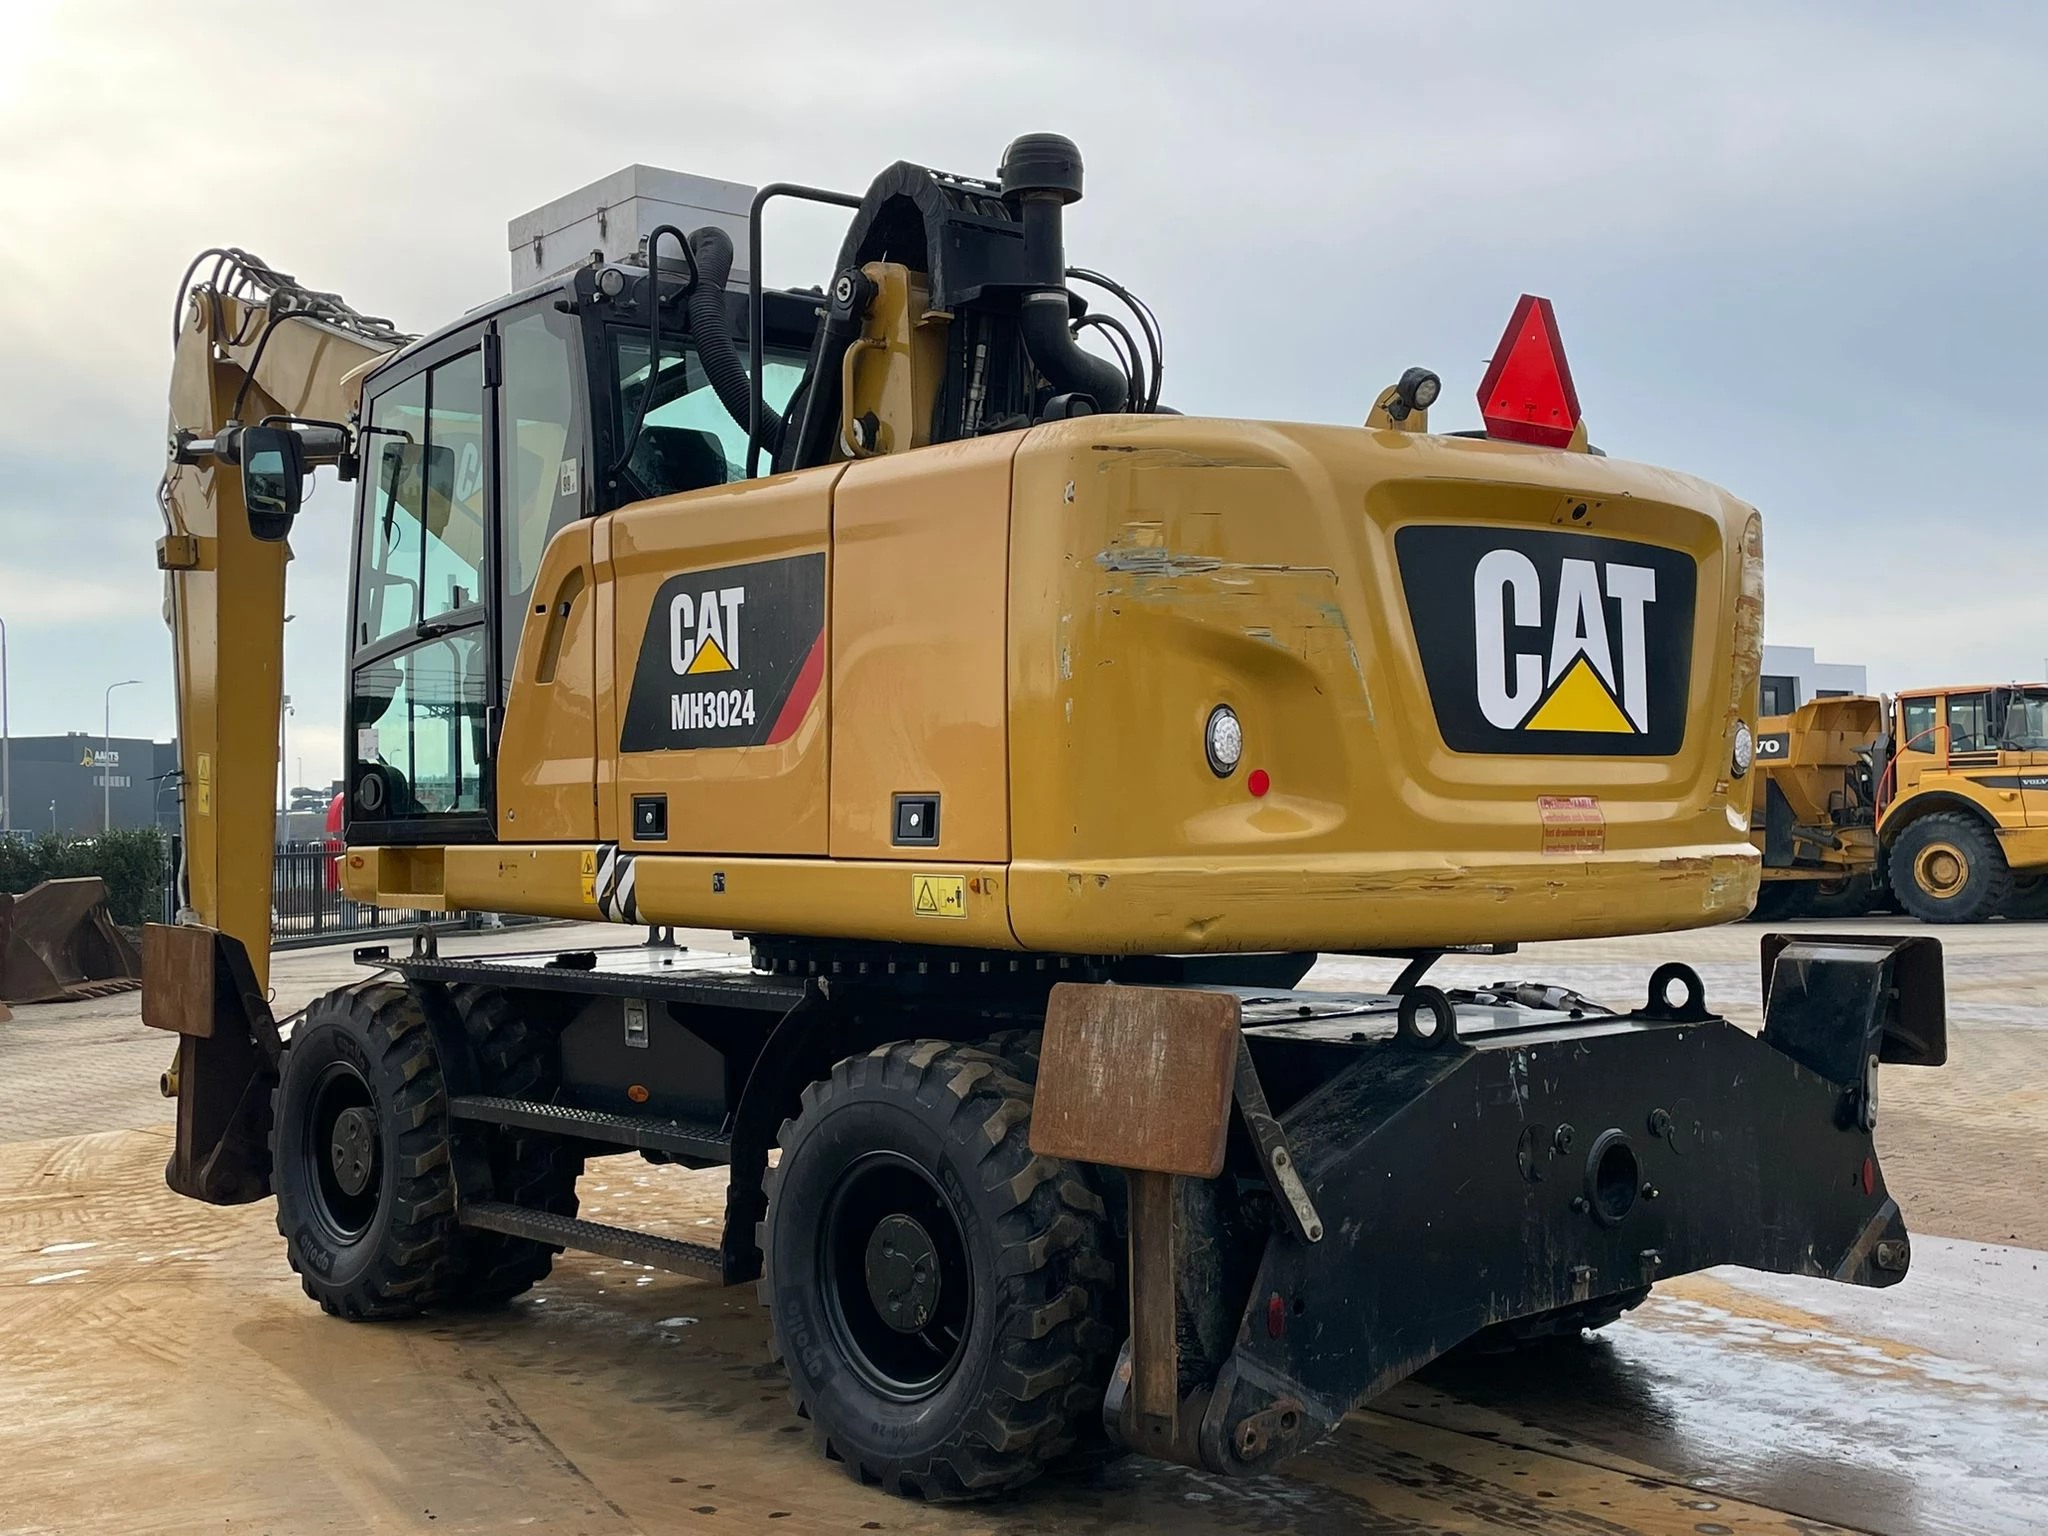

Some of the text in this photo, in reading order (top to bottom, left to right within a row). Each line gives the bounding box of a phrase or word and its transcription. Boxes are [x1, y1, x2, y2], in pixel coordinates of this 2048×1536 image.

[670, 587, 745, 676] CAT
[1474, 549, 1656, 734] CAT
[671, 689, 755, 730] MH3024
[300, 1234, 330, 1271] apollo
[787, 1301, 824, 1378] apollo
